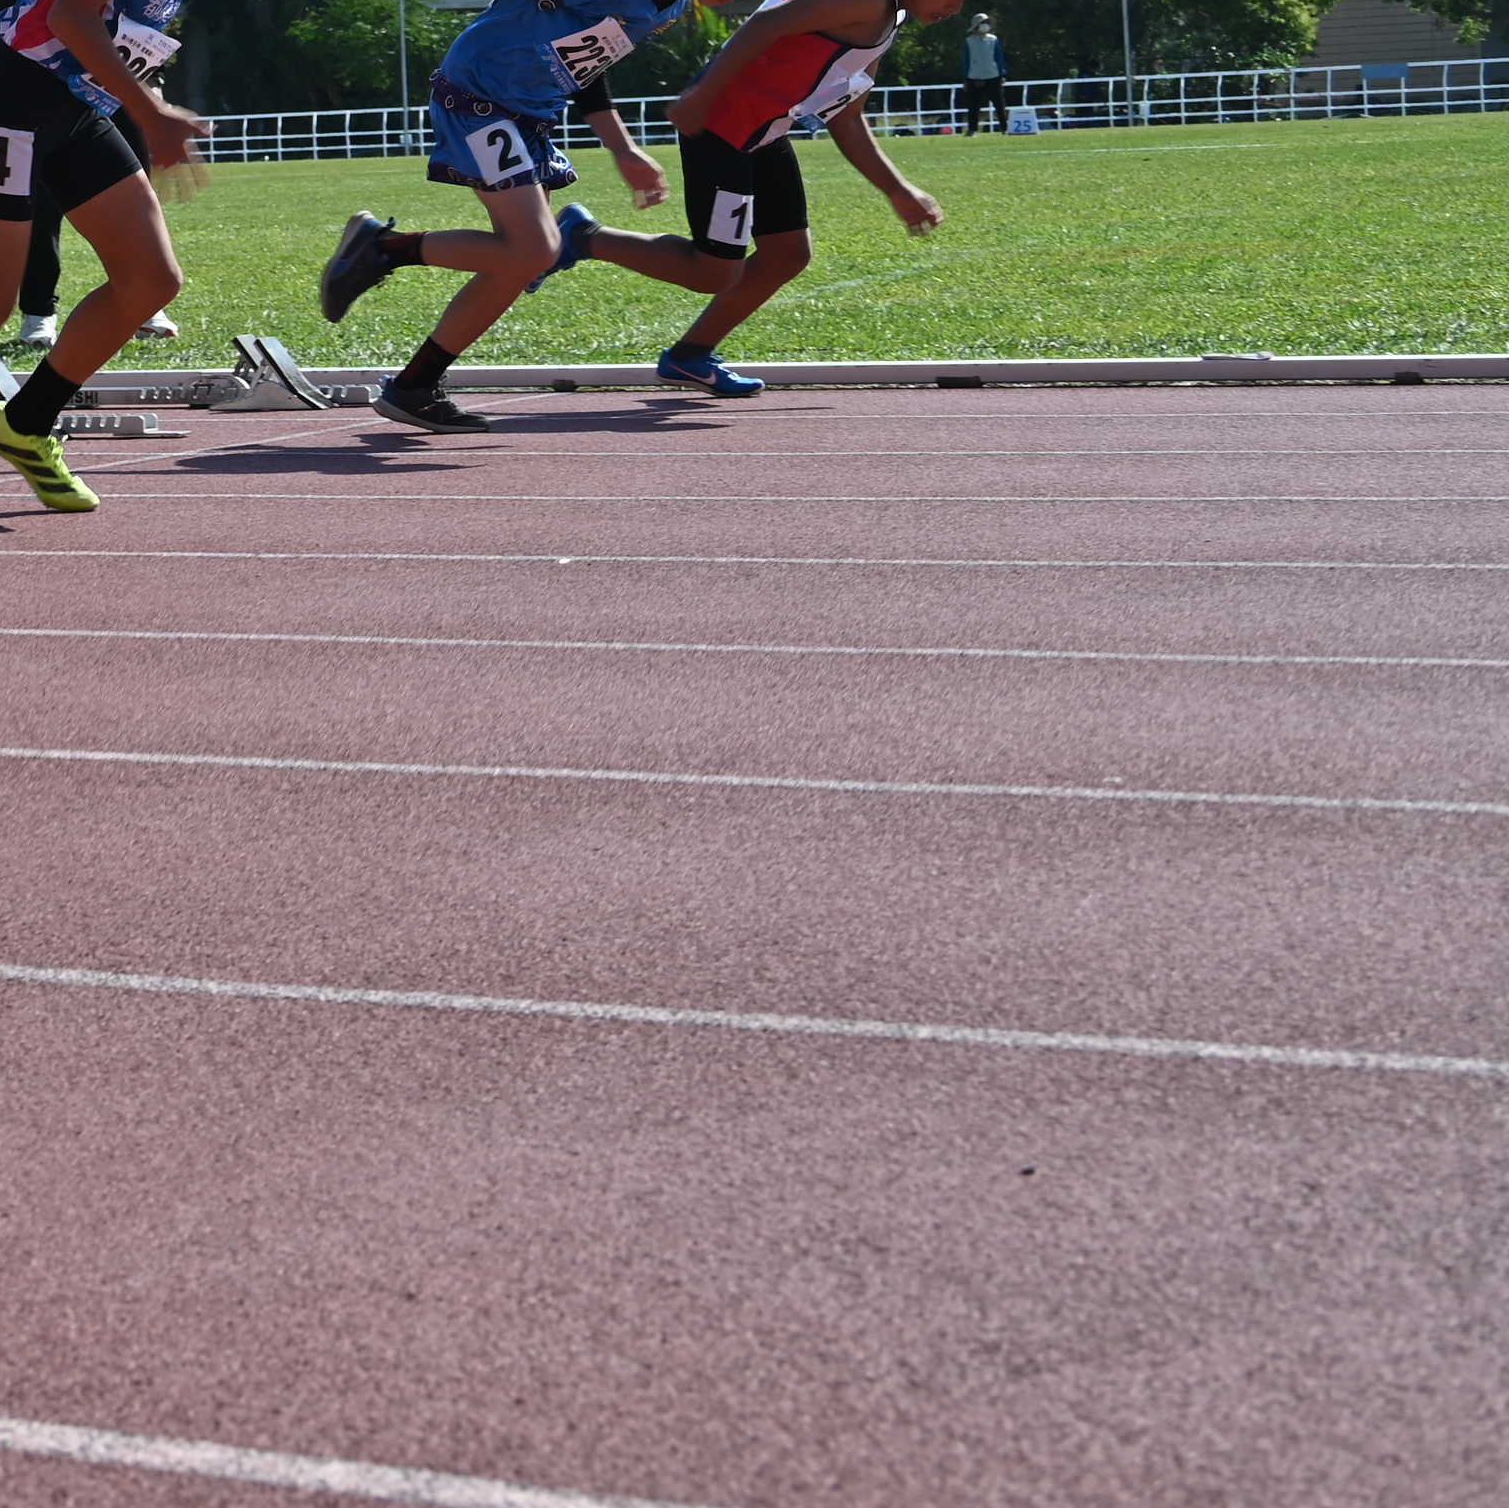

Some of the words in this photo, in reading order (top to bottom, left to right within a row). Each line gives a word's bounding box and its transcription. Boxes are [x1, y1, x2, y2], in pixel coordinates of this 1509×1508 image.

[1013, 120, 1031, 133] 25
[489, 130, 522, 172] 2
[730, 203, 751, 240] 1
